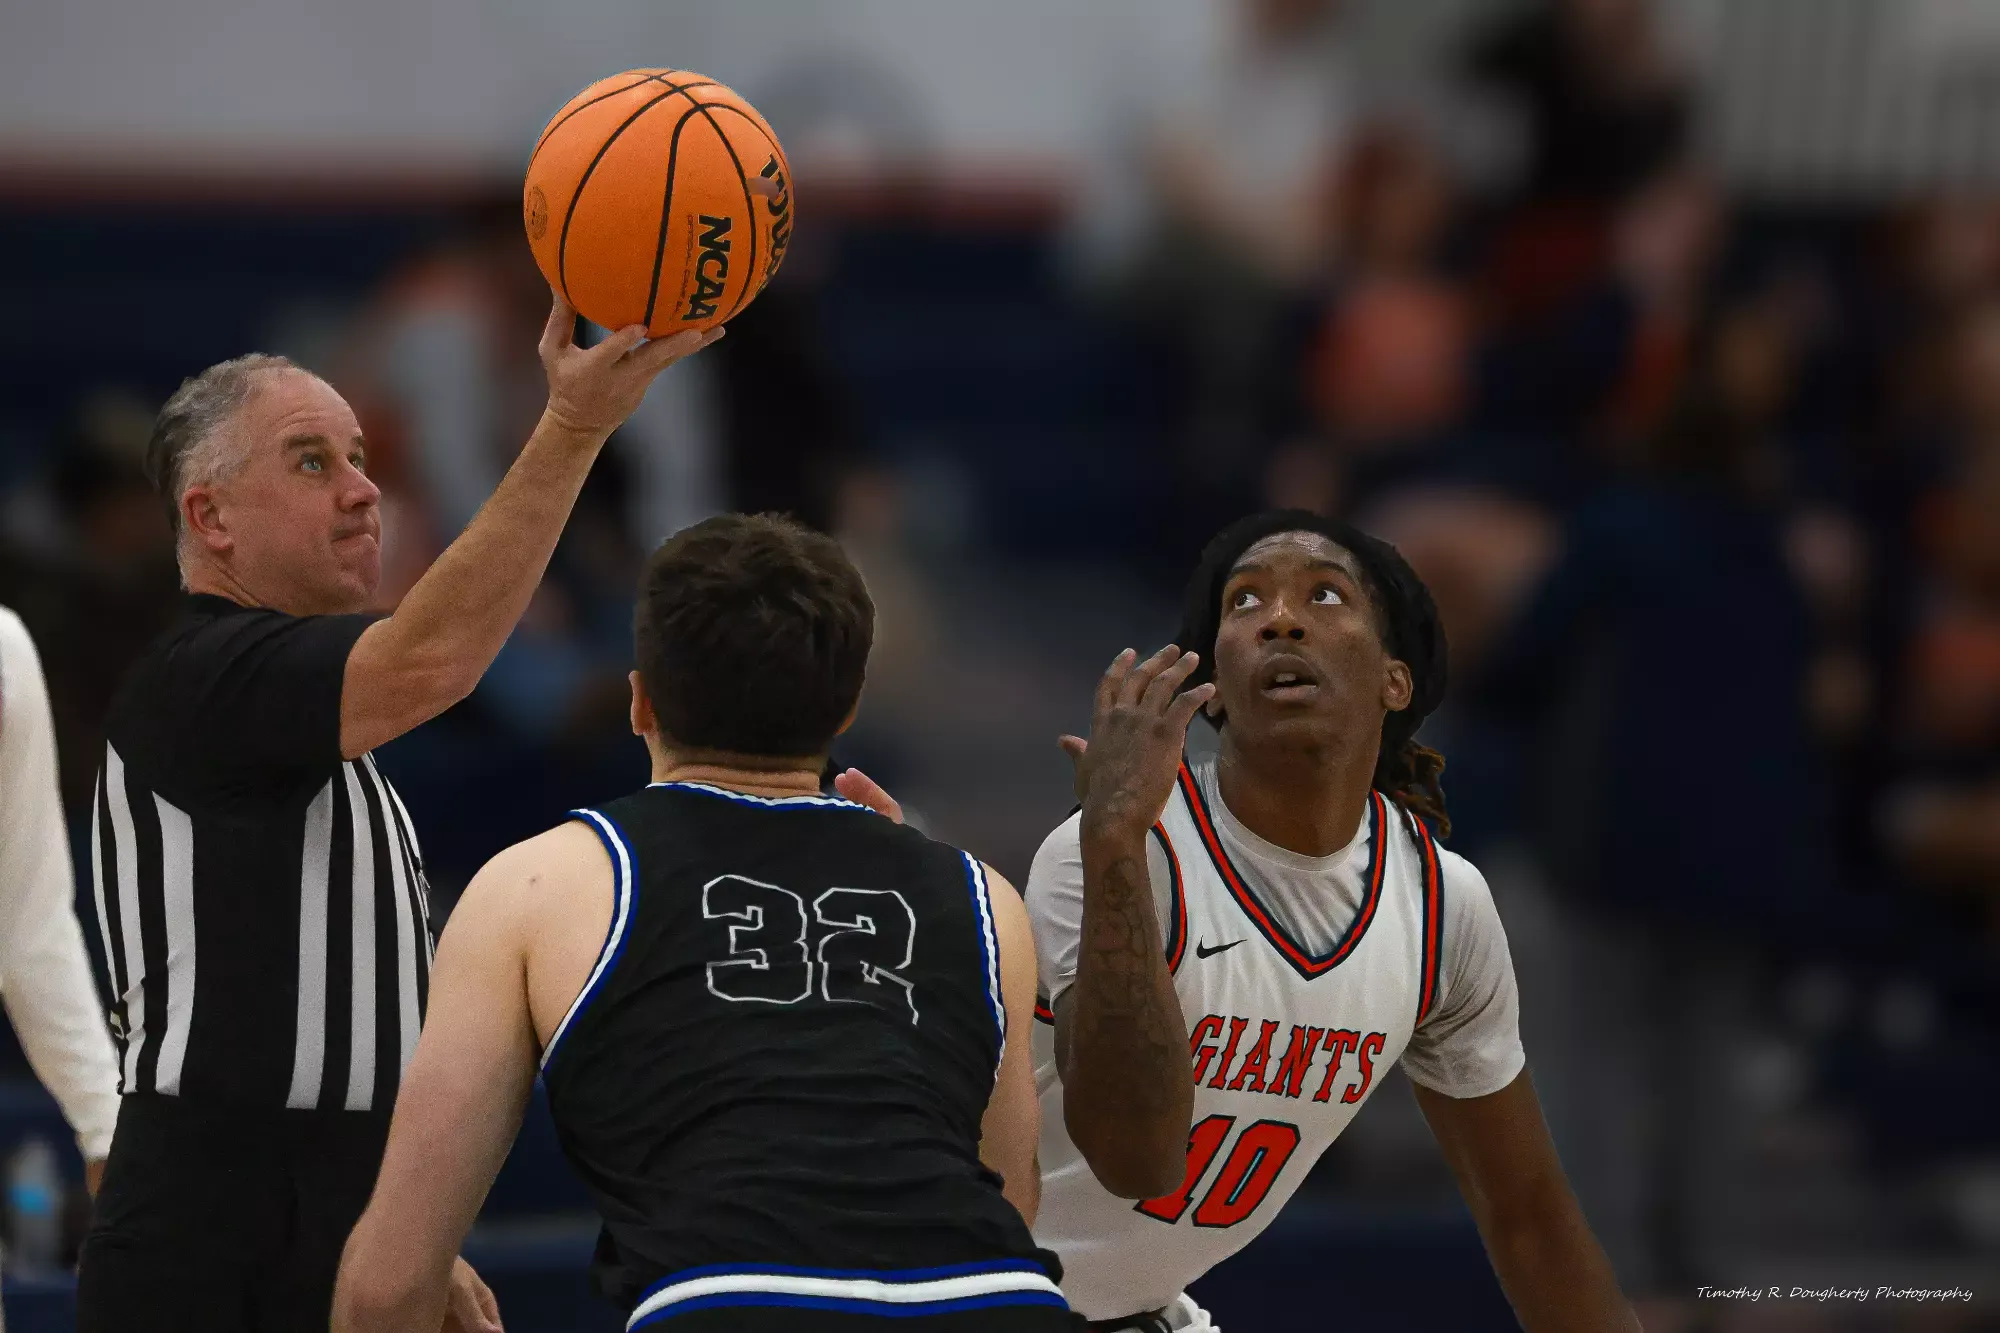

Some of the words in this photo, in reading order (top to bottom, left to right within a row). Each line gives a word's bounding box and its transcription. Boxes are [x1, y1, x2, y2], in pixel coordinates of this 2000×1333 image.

[681, 213, 733, 321] NCAA
[702, 874, 919, 1026] 32
[1190, 1014, 1388, 1104] GIANTS
[1132, 1114, 1301, 1229] 10
